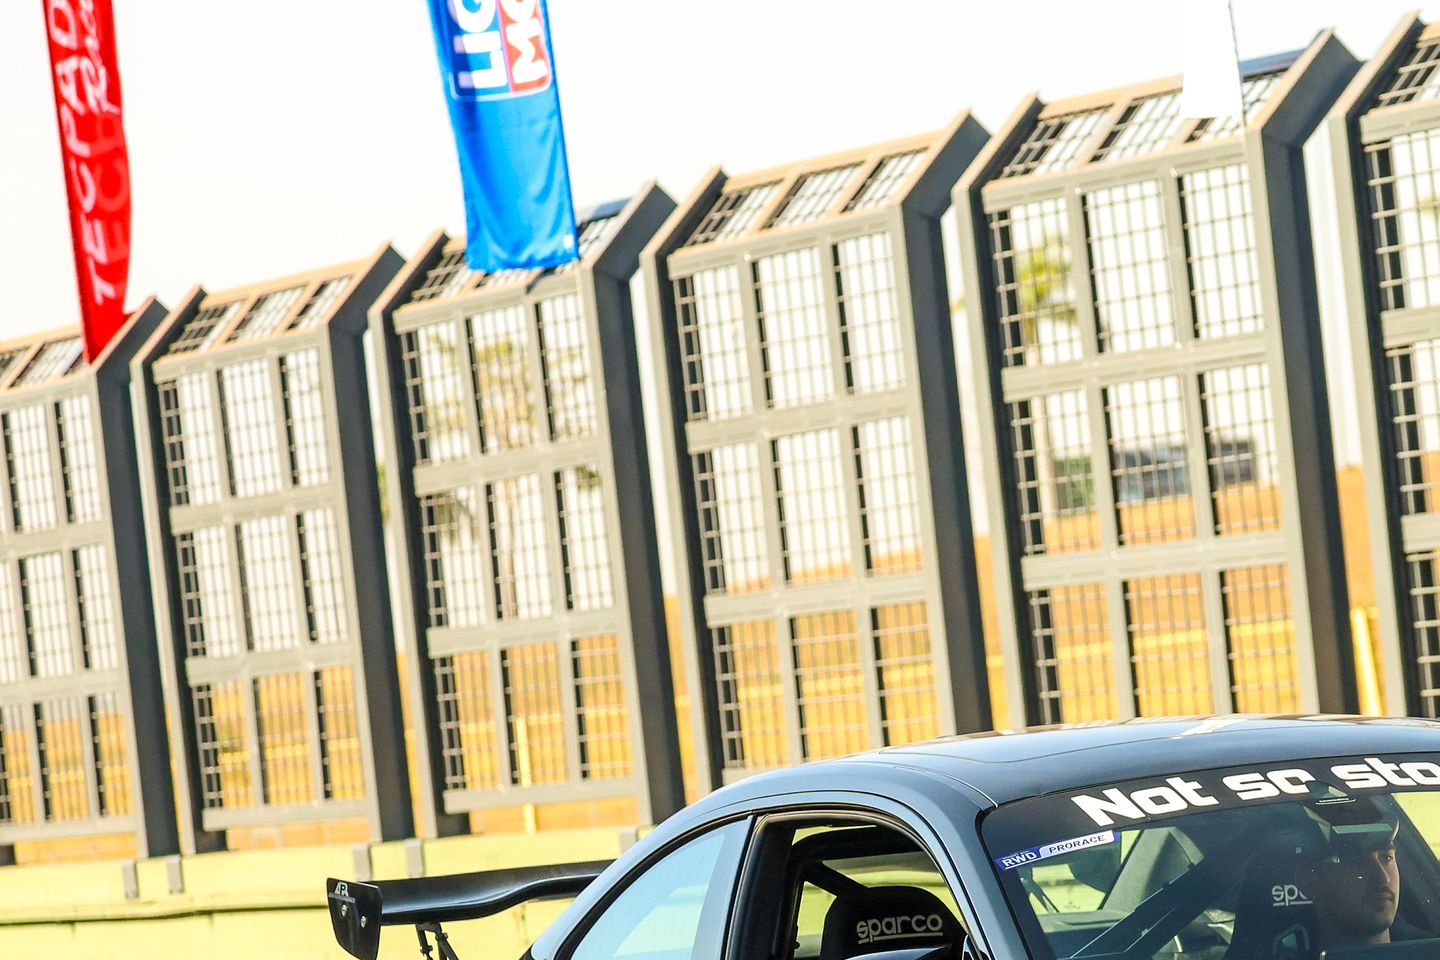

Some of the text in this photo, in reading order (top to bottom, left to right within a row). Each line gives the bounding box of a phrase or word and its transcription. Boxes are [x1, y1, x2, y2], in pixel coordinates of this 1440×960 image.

[1071, 776, 1220, 827] Not
[1002, 851, 1037, 868] RWD
[1048, 834, 1106, 854] PRORACE
[857, 914, 944, 943] sparco
